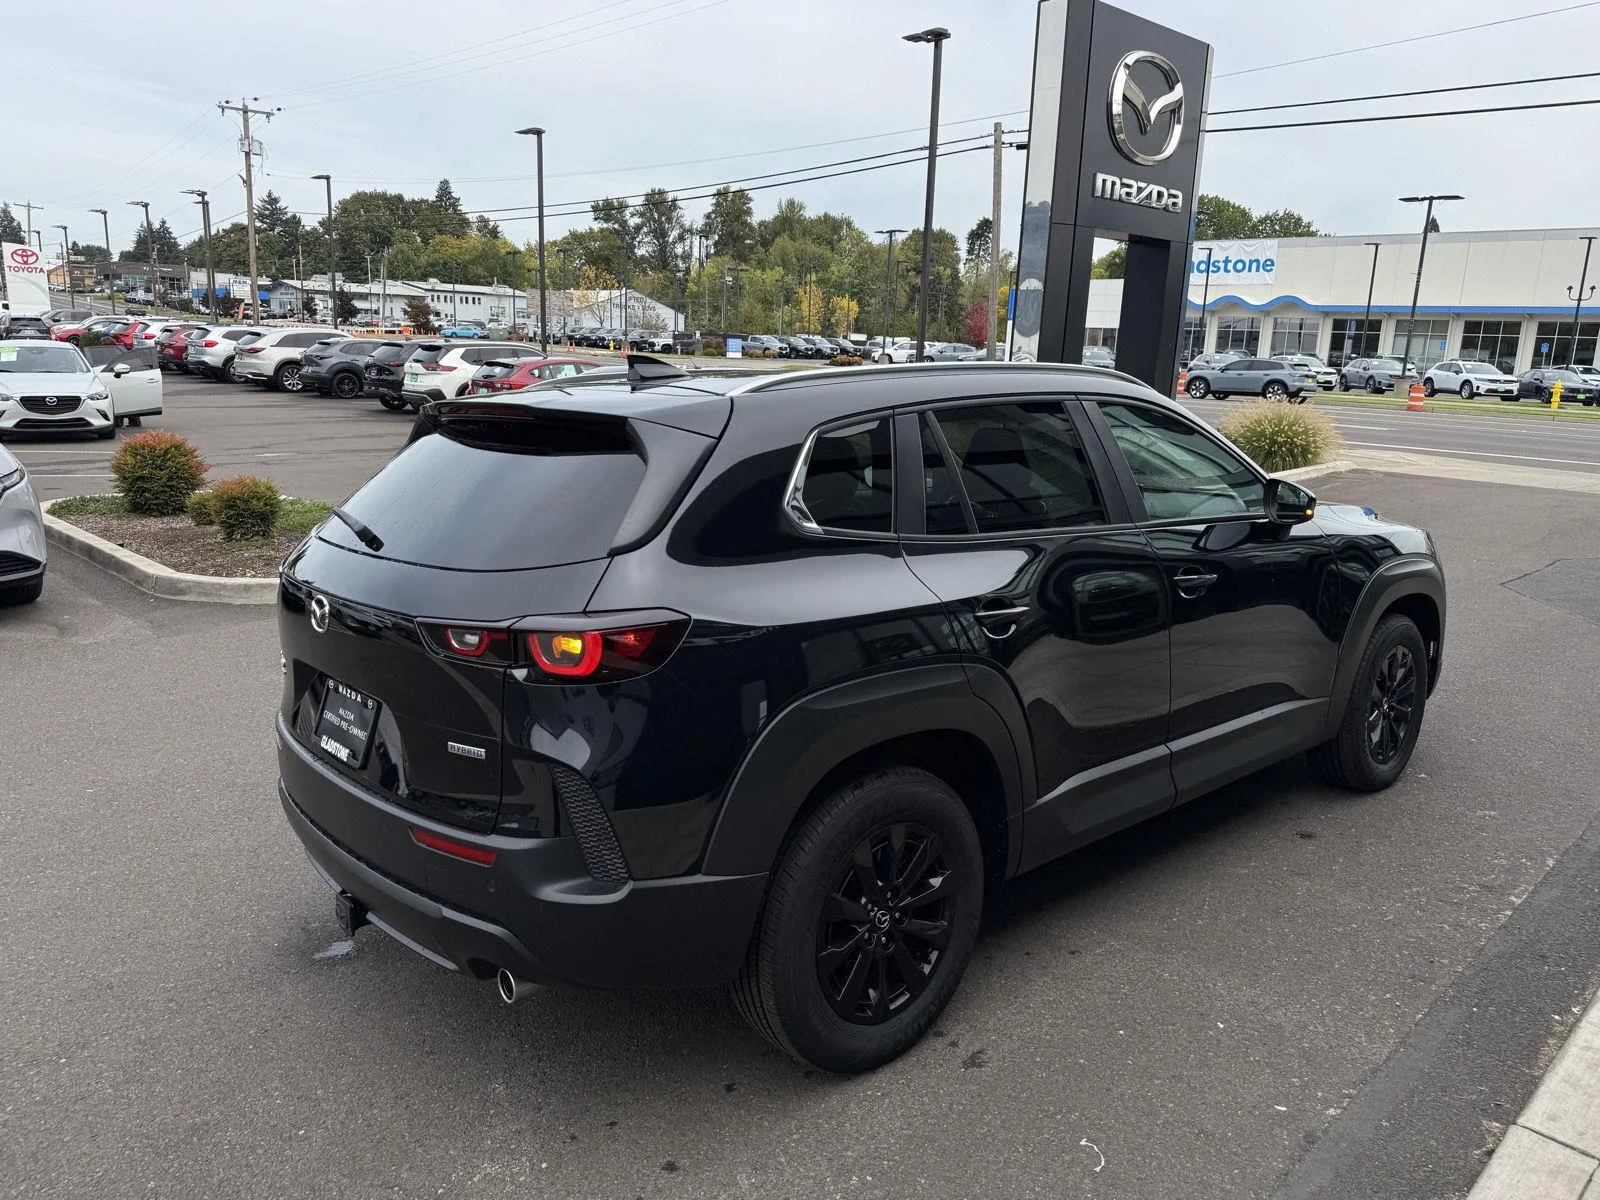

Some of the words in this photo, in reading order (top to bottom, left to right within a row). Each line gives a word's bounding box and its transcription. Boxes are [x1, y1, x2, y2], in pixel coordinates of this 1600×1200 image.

[1093, 172, 1183, 212] mazda
[7, 265, 45, 274] TOYOTA
[338, 684, 362, 702] MAZDA
[323, 710, 340, 726] CERTIFIED
[338, 707, 355, 721] MAZDA
[320, 735, 350, 762] GLADSTONE
[449, 743, 484, 758] HYBRID
